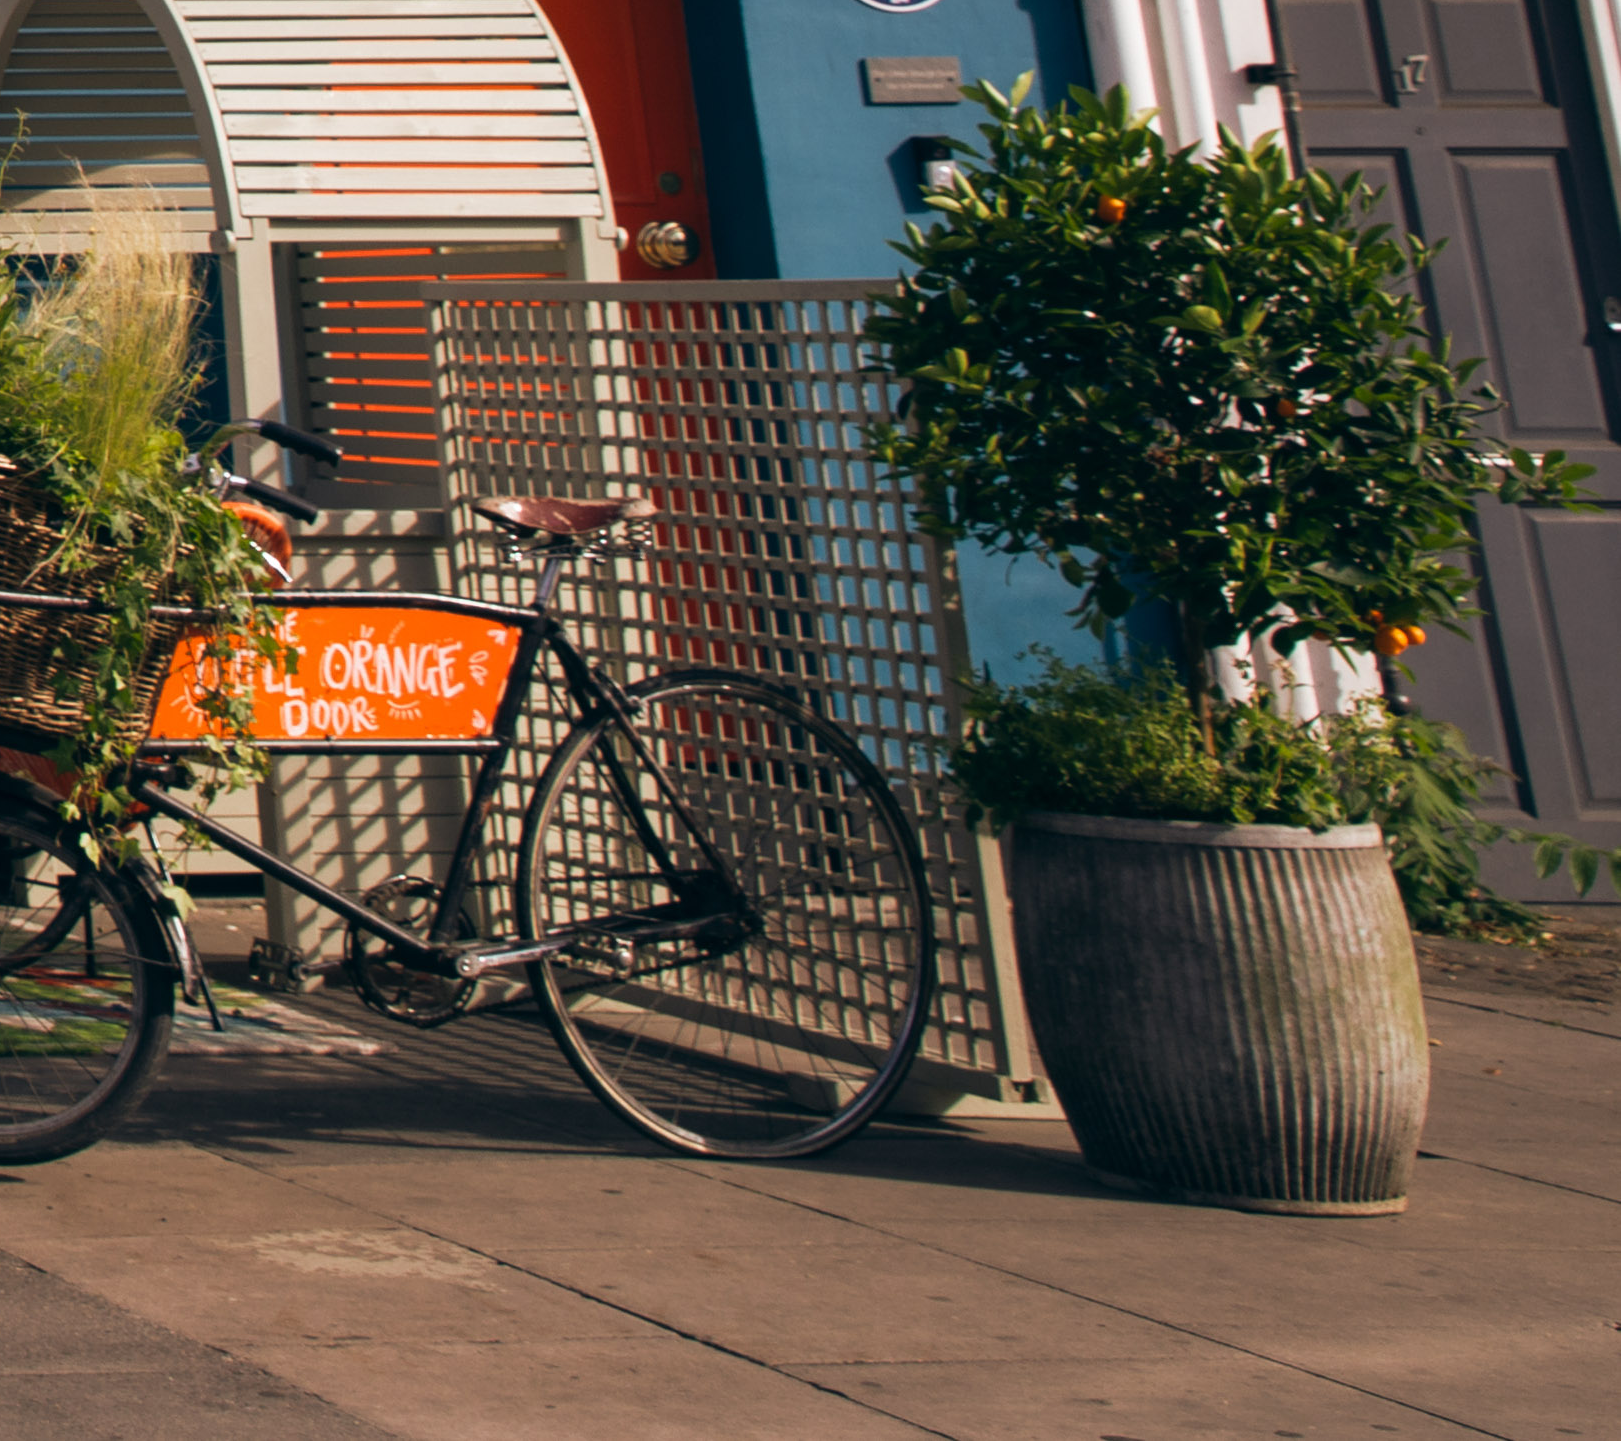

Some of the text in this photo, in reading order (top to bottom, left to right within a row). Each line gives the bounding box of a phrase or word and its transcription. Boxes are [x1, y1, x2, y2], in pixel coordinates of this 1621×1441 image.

[1400, 55, 1429, 93] 17
[322, 639, 465, 699] ORANGE
[280, 695, 379, 738] DOOR
